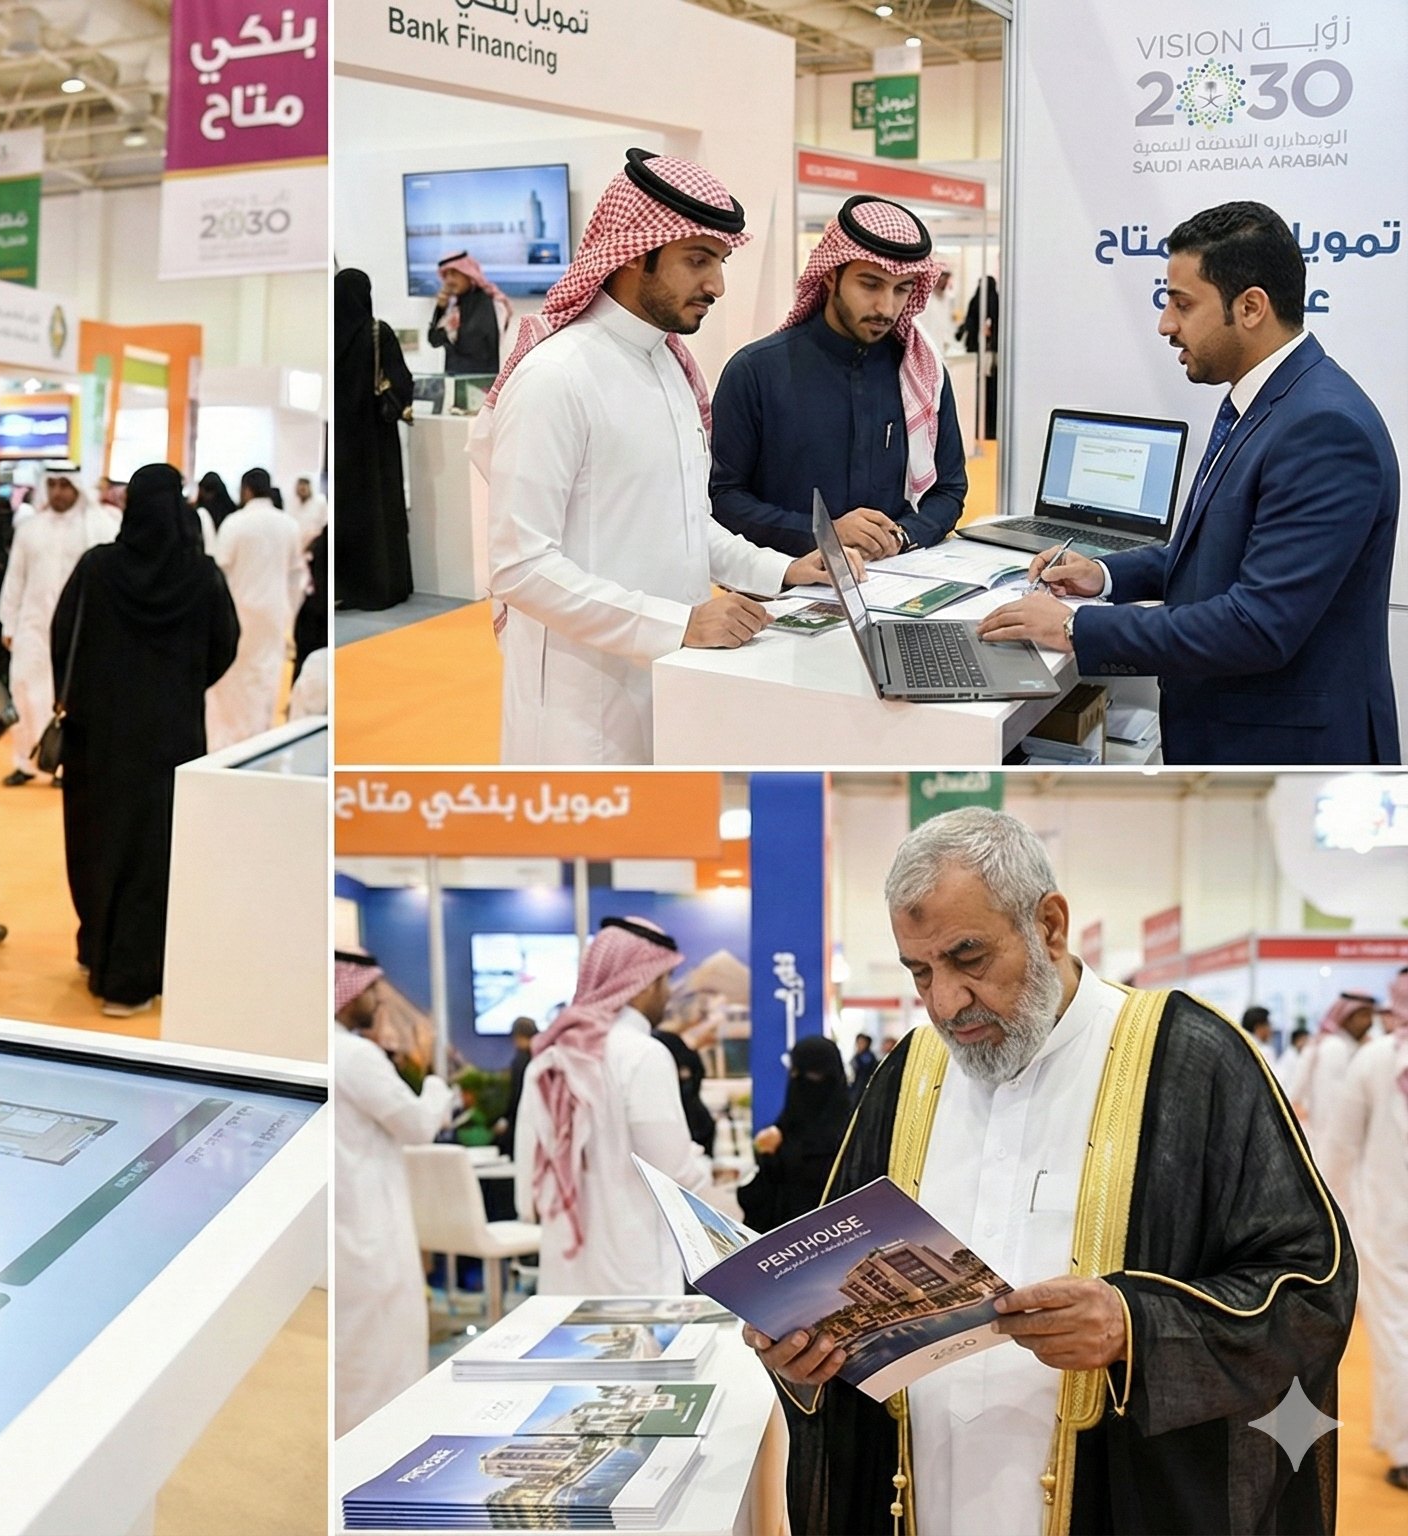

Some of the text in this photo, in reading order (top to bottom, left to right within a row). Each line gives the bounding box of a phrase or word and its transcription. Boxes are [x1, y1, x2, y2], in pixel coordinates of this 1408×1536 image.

[190, 9, 317, 85] بنكي
[388, 7, 558, 75] Bank Financing
[1136, 28, 1243, 60] VISION
[200, 82, 305, 141] متاح
[1132, 159, 1182, 174] SAUDI
[1268, 153, 1349, 169] ARABIAN
[335, 779, 631, 830] تمويل بنكي متاح
[757, 1214, 864, 1273] PENTHOUSE
